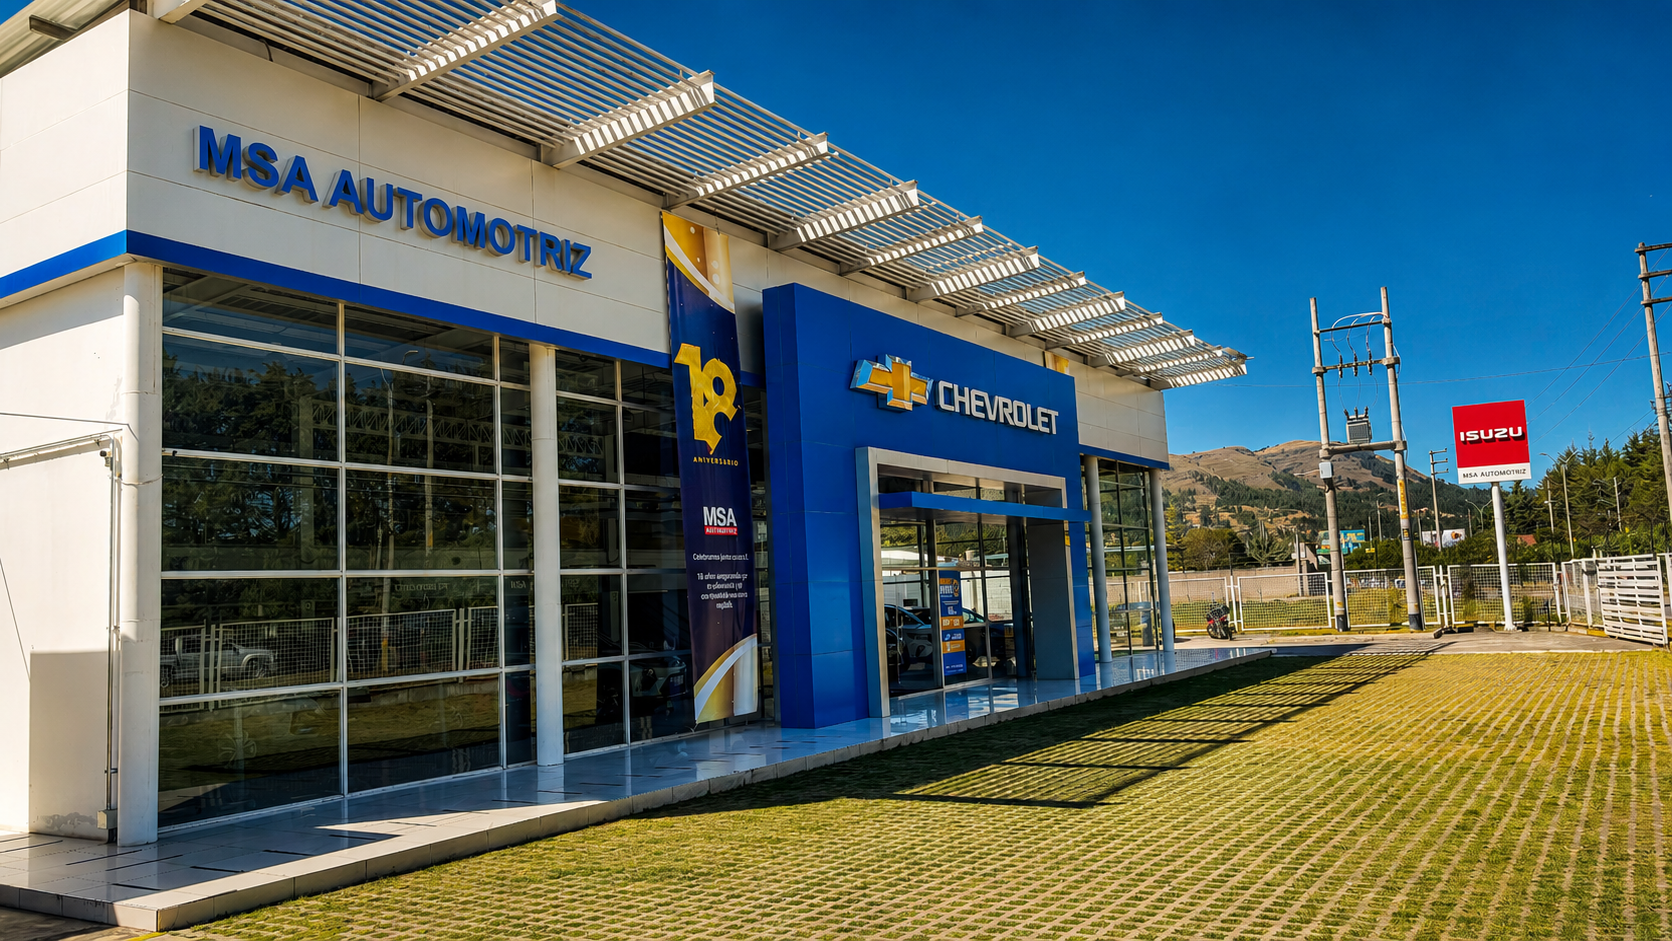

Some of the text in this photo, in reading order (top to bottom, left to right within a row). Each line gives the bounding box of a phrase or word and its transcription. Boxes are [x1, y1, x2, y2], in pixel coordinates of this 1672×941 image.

[195, 125, 593, 280] MSA AUTOMOTRIZ
[937, 380, 1059, 435] CHEVROLET
[1459, 426, 1523, 442] ISUZU
[1480, 468, 1526, 478] AUTOMOTRIZ
[703, 506, 738, 526] MSA
